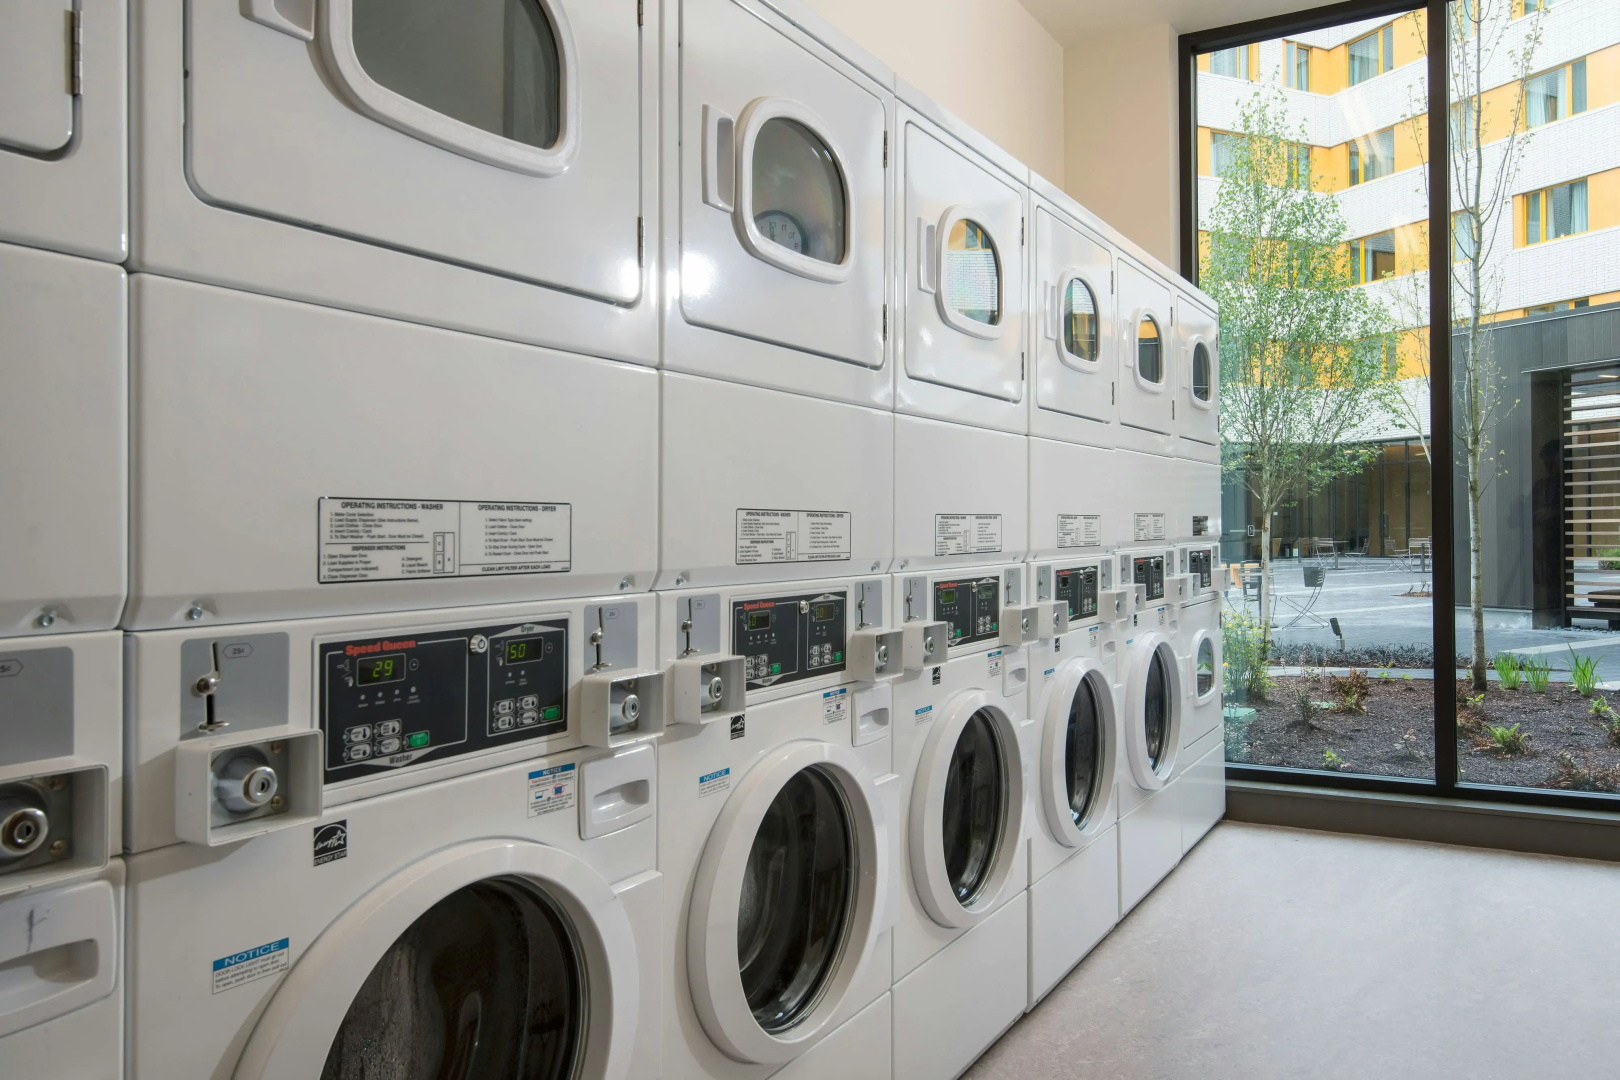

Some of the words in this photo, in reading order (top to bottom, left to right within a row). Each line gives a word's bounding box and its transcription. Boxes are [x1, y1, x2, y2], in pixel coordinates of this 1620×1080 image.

[345, 641, 381, 656] Speed
[382, 639, 416, 651] Queen
[373, 660, 393, 677] 29
[389, 754, 412, 764] Washer
[543, 766, 562, 775] NOTICE
[703, 770, 726, 781] NOTICE
[225, 942, 279, 966] NOTICE
